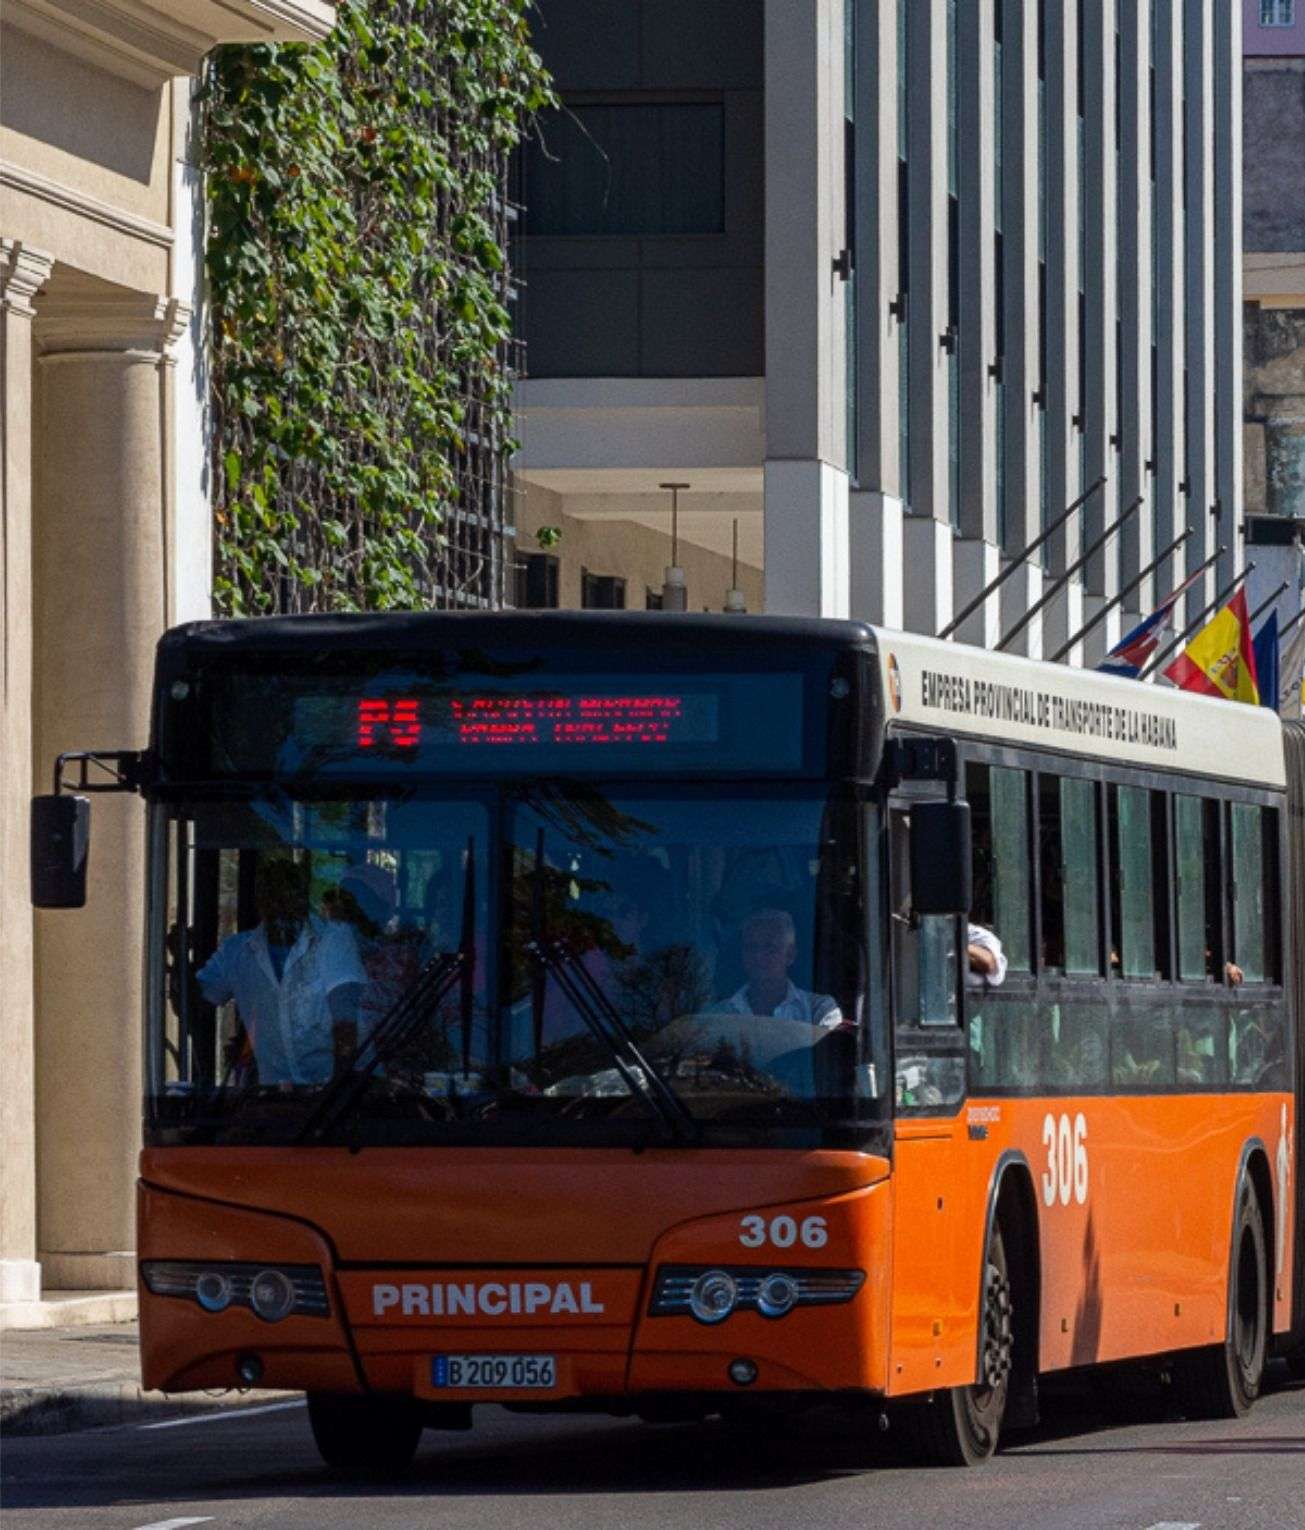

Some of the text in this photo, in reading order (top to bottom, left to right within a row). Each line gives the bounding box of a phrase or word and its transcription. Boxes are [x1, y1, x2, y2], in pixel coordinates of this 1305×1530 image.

[921, 669, 1177, 749] EMPRESA PROVINCIAL DE TRANSPORTE DE LA HABANA
[1042, 1111, 1088, 1207] 306
[738, 1215, 829, 1248] 306
[372, 1282, 605, 1316] PRINCIPAL
[449, 1359, 463, 1385] B
[467, 1359, 508, 1385] 209
[512, 1359, 553, 1385] 056
